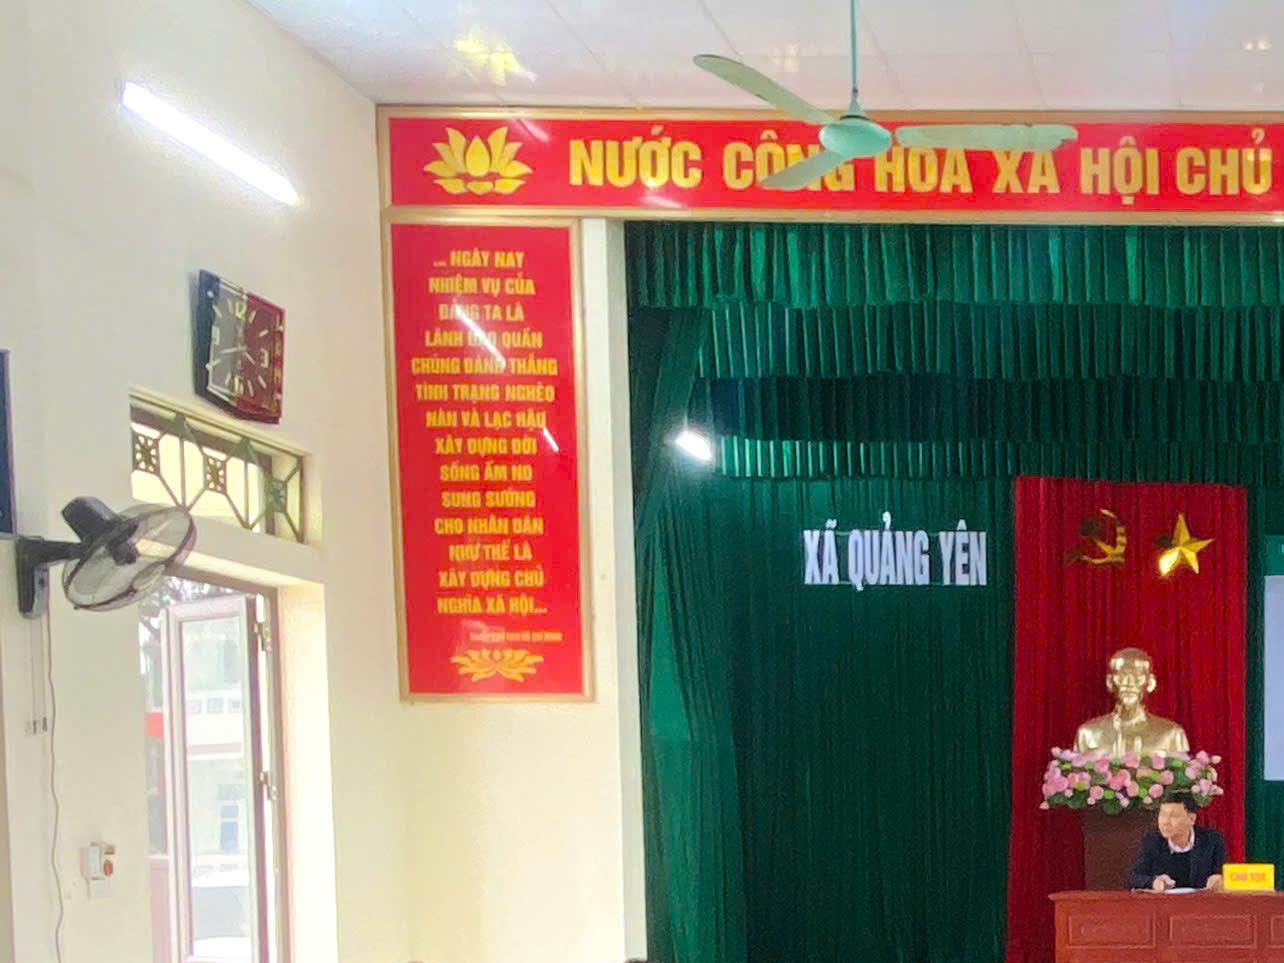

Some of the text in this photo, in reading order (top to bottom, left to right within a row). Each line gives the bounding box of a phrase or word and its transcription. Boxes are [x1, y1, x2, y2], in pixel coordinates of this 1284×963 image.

[569, 125, 701, 189] NƯỚC
[1079, 136, 1160, 205] HỘI
[1177, 130, 1273, 197] CHỦ
[494, 252, 524, 268] NAY
[482, 277, 500, 297] VỤ
[505, 272, 535, 295] CỦA
[484, 304, 502, 320] TA
[506, 301, 525, 321] LÀ
[461, 408, 480, 427] VÀ
[484, 411, 512, 431] LẠC
[516, 409, 546, 432] HẬU
[435, 434, 463, 454] XÂY
[512, 465, 532, 481] NO
[442, 491, 481, 508] SUNG
[434, 515, 544, 535] CHO NHÂN DÂN
[449, 539, 532, 561] NHƯ THẾ LÀ
[803, 511, 987, 592] XÃ QUẢNG YÊN
[439, 568, 466, 587] XÂY
[514, 565, 544, 587] CHỦ
[485, 594, 505, 614] XÃ
